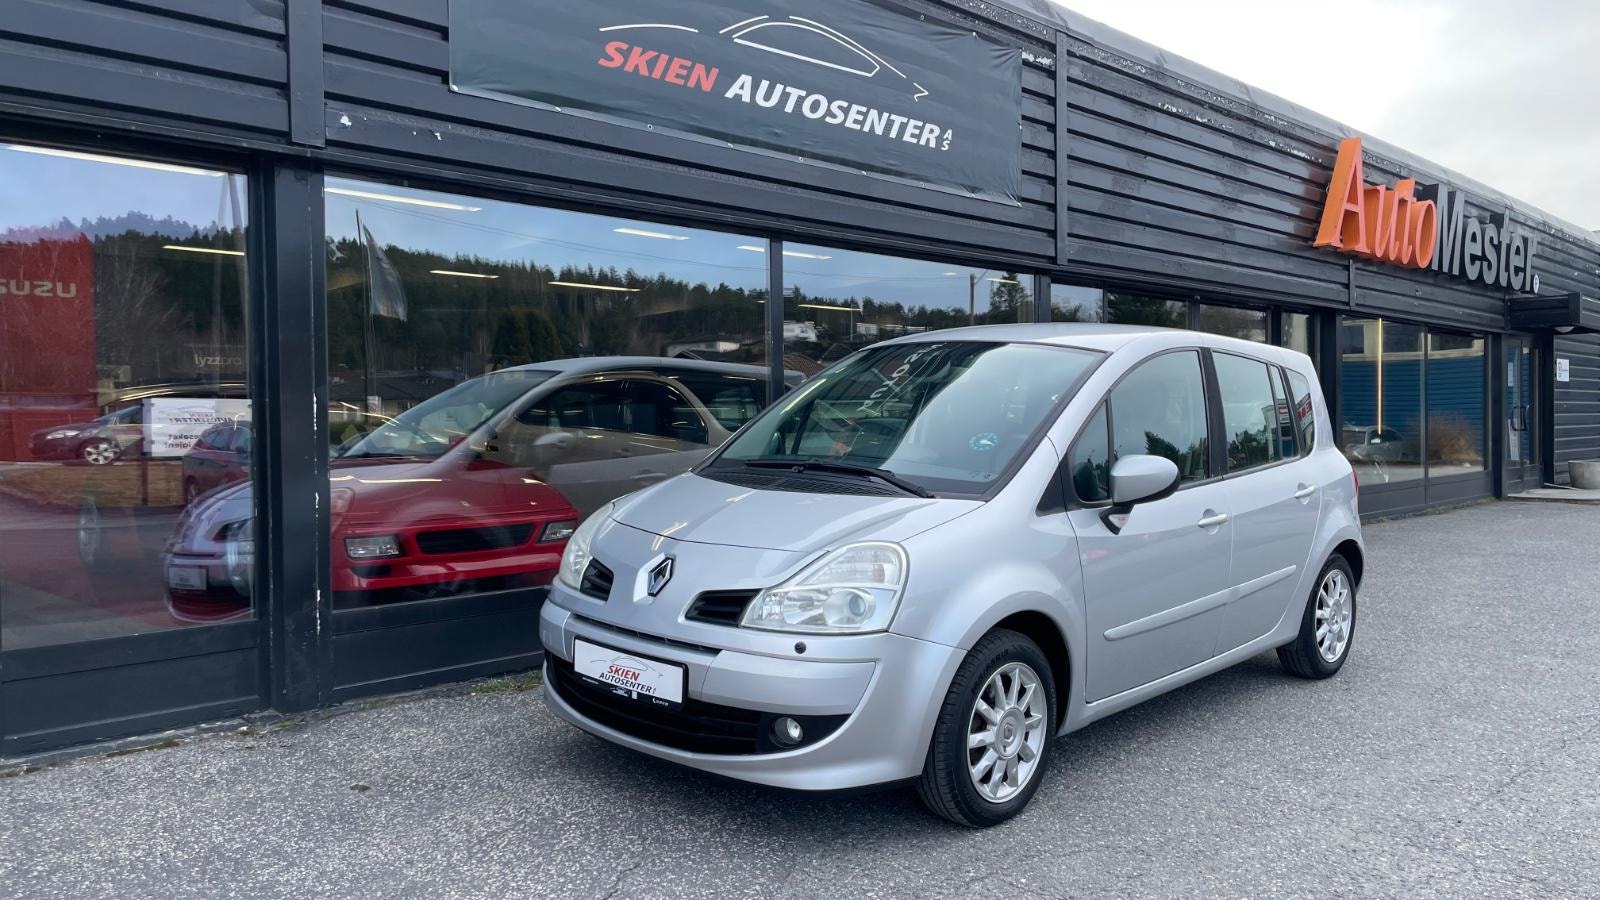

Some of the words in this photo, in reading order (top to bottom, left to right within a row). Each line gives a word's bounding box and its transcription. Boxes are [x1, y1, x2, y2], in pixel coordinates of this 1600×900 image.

[598, 41, 719, 93] SKIEN
[724, 73, 941, 148] AUTOSENTER
[598, 672, 653, 693] AUTOSENTER
[607, 665, 640, 682] SKIEN
